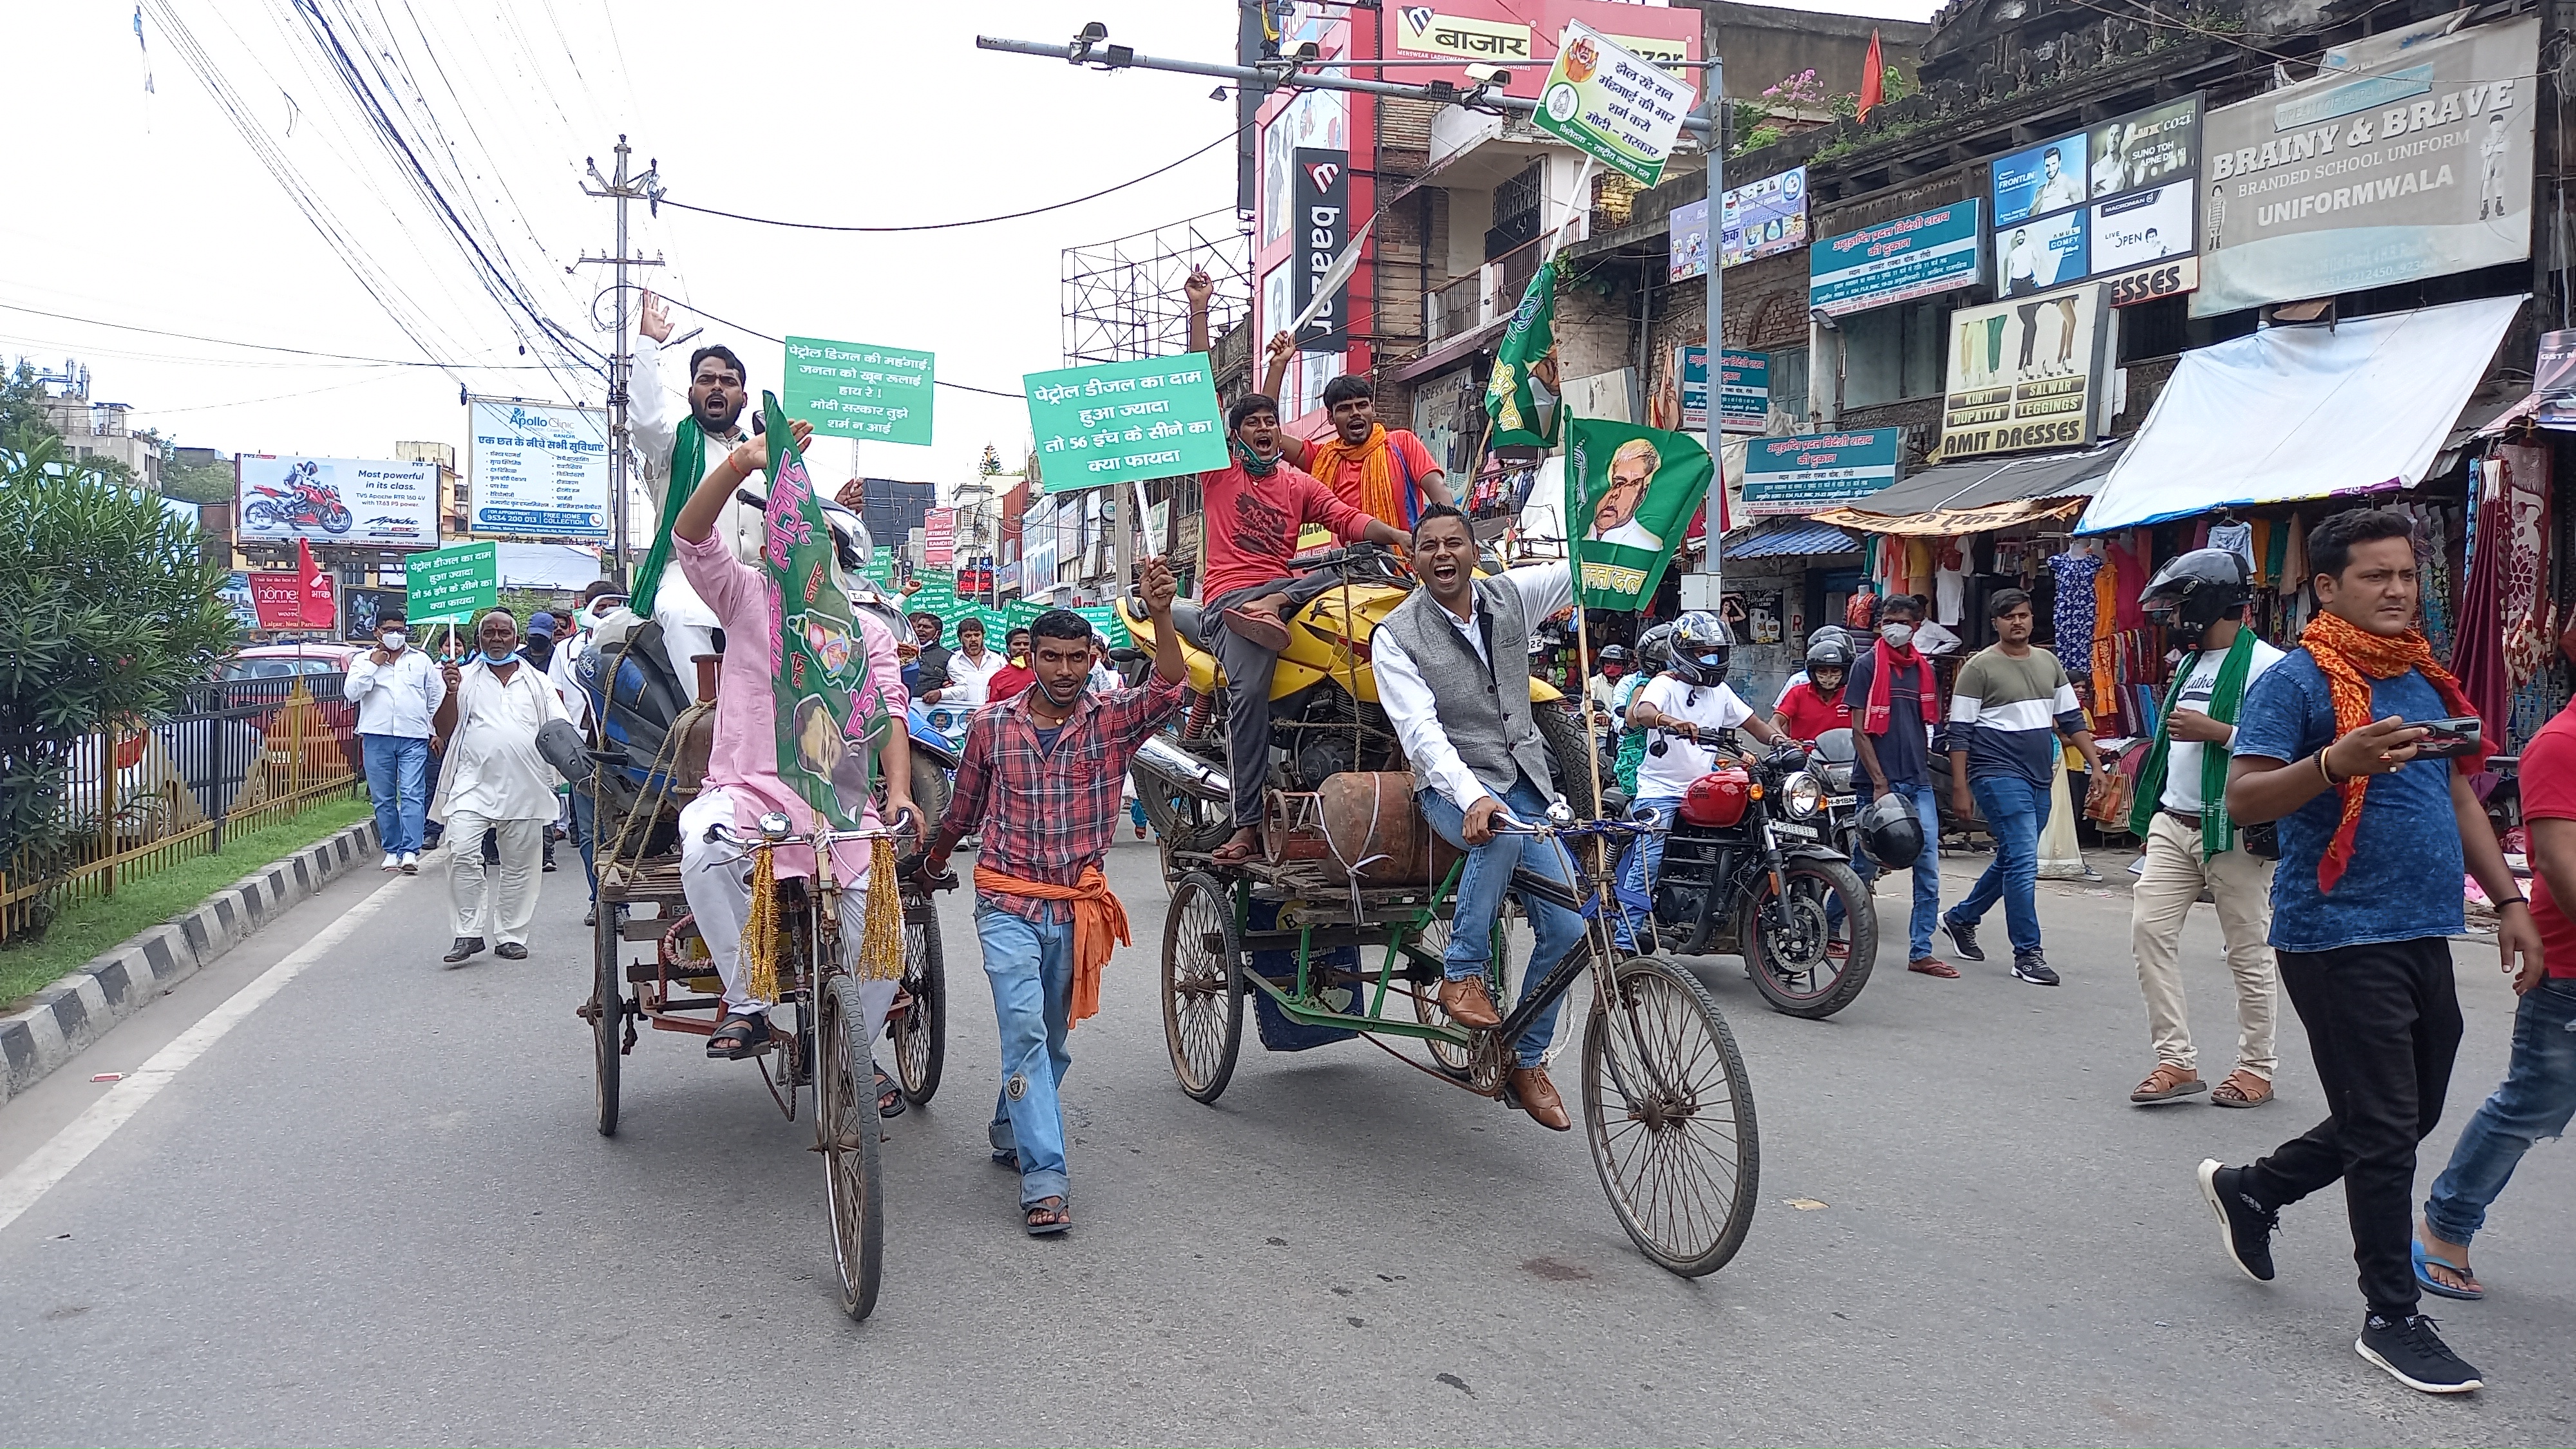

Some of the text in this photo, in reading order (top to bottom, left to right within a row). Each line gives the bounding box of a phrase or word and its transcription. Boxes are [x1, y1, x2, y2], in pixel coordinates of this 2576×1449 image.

[1435, 28, 1528, 57] बाजार
[1397, 50, 1428, 59] MENSWEAR
[1615, 61, 1639, 82] झेल
[1640, 73, 1654, 91] रहे
[1608, 102, 1629, 119] शर्म
[1638, 97, 1654, 112] की
[1654, 106, 1676, 124] मार
[2324, 97, 2338, 111] OF
[1586, 111, 1660, 158] मोदी सरकार
[2130, 124, 2159, 140] LUX
[2211, 80, 2514, 182] BRAINY & BRAVE
[2132, 141, 2174, 160] SUNO TOH
[2139, 147, 2186, 168] APNE DIL KI
[2237, 129, 2469, 198] BRANDED SCHOOL UNIFORM
[2258, 164, 2454, 226] UNIFORMWALA
[1895, 217, 1922, 233] विदेशी
[2105, 231, 2120, 240] LIVE
[1868, 239, 1911, 256] की दुकान
[788, 344, 931, 371] पेट्रोल डिजल की महंगाई,
[799, 364, 922, 387] जनता को खूब रूलाई
[838, 386, 862, 397] हाय
[865, 386, 875, 398] रे
[1034, 370, 1202, 406] पेट्रोल डीजल का दाम
[1421, 374, 1468, 403] DRESS WELL
[1965, 380, 2072, 406] KURTI SALWAR
[810, 399, 909, 421] मोदी सरकार तुझे
[1077, 399, 1170, 428] हुआ ज्यादा
[1953, 398, 2079, 425] DUPATTA LEGGINGS
[509, 415, 575, 429] Apollo Clinic
[827, 417, 892, 435] शर्म न आई
[478, 436, 604, 453] एक छत के नीचे सभी सुविधाएं
[1043, 419, 1213, 453] तो 56 इंच के सीने का
[1823, 434, 1850, 448] विदेशी
[1944, 420, 2079, 455] AMIT DRESSES
[1086, 450, 1180, 473] क्या फायदा
[1797, 453, 1837, 468] की दुकान
[358, 469, 424, 481] Most powerful
[377, 481, 386, 489] its
[389, 482, 416, 491] class.
[410, 560, 431, 573] पेट्रोल
[433, 556, 459, 568] डीजल
[475, 551, 492, 560] दाम
[429, 568, 474, 585] हुआ ज्यादा
[1611, 567, 1648, 594] दल
[412, 579, 493, 600] तो 56 इंच के सीने का
[430, 596, 475, 610] क्या फायदा
